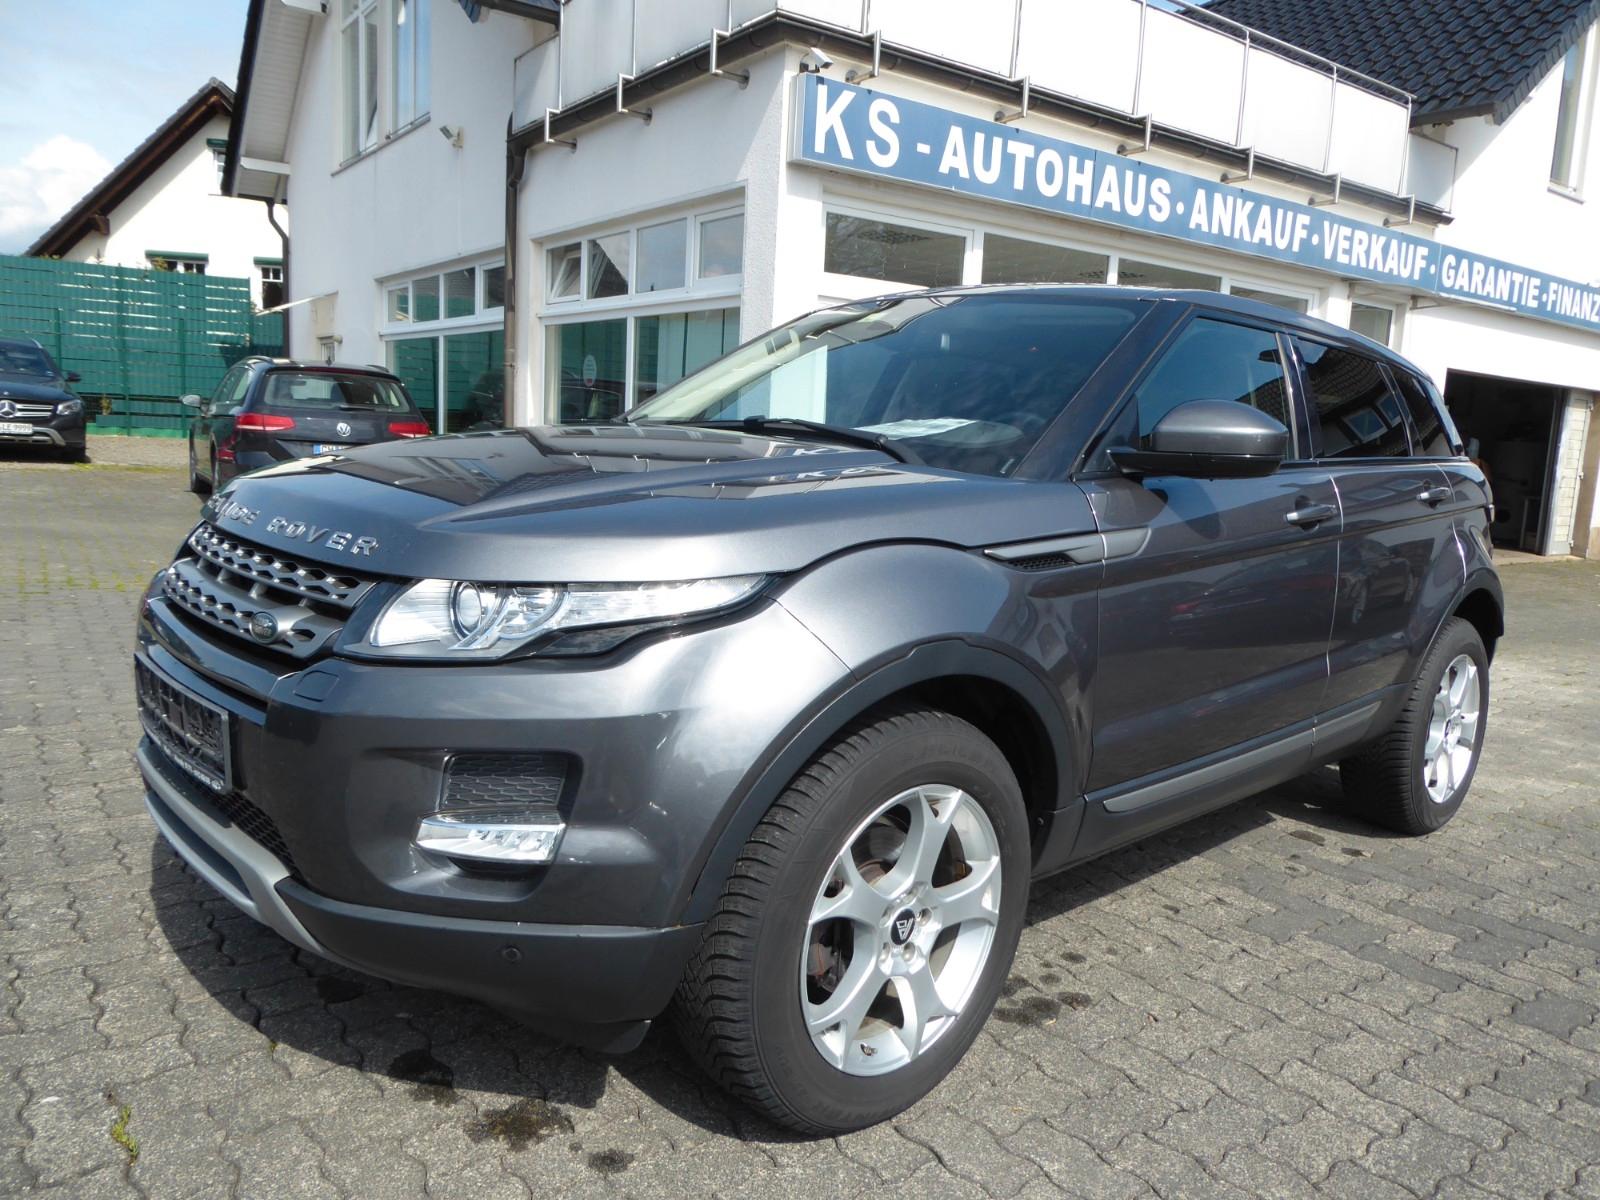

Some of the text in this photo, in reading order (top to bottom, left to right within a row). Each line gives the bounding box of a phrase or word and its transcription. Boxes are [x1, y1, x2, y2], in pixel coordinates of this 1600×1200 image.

[1188, 188, 1311, 253] ANKAUF
[1322, 220, 1429, 281] VERKAUF
[1441, 255, 1542, 308] GARANTIE
[266, 515, 379, 556] ROVER
